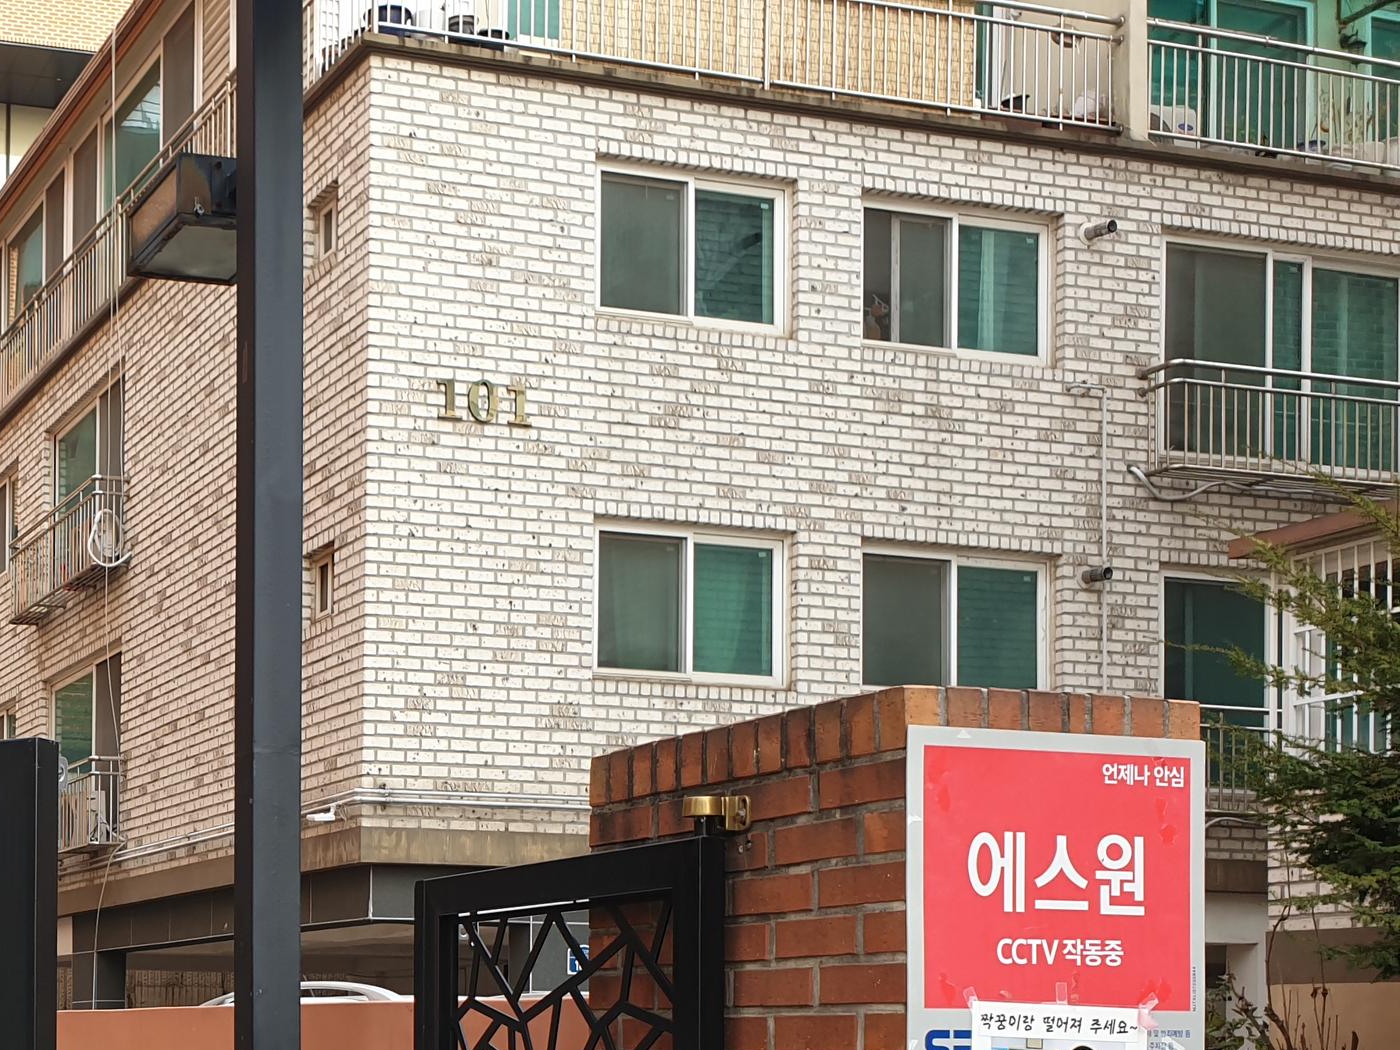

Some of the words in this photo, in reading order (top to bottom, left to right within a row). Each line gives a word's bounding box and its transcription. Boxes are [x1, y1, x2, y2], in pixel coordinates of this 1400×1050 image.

[436, 379, 532, 428] 101
[1102, 763, 1150, 787] 언제나
[1153, 765, 1185, 788] 안심
[967, 831, 1145, 916] 에스원
[996, 938, 1059, 966] CCTV
[1062, 939, 1124, 967] 작동중
[980, 1013, 1035, 1032] 짝꿍이랑
[1043, 1016, 1082, 1033] 떨어져
[1090, 1019, 1138, 1035] 주세요~
